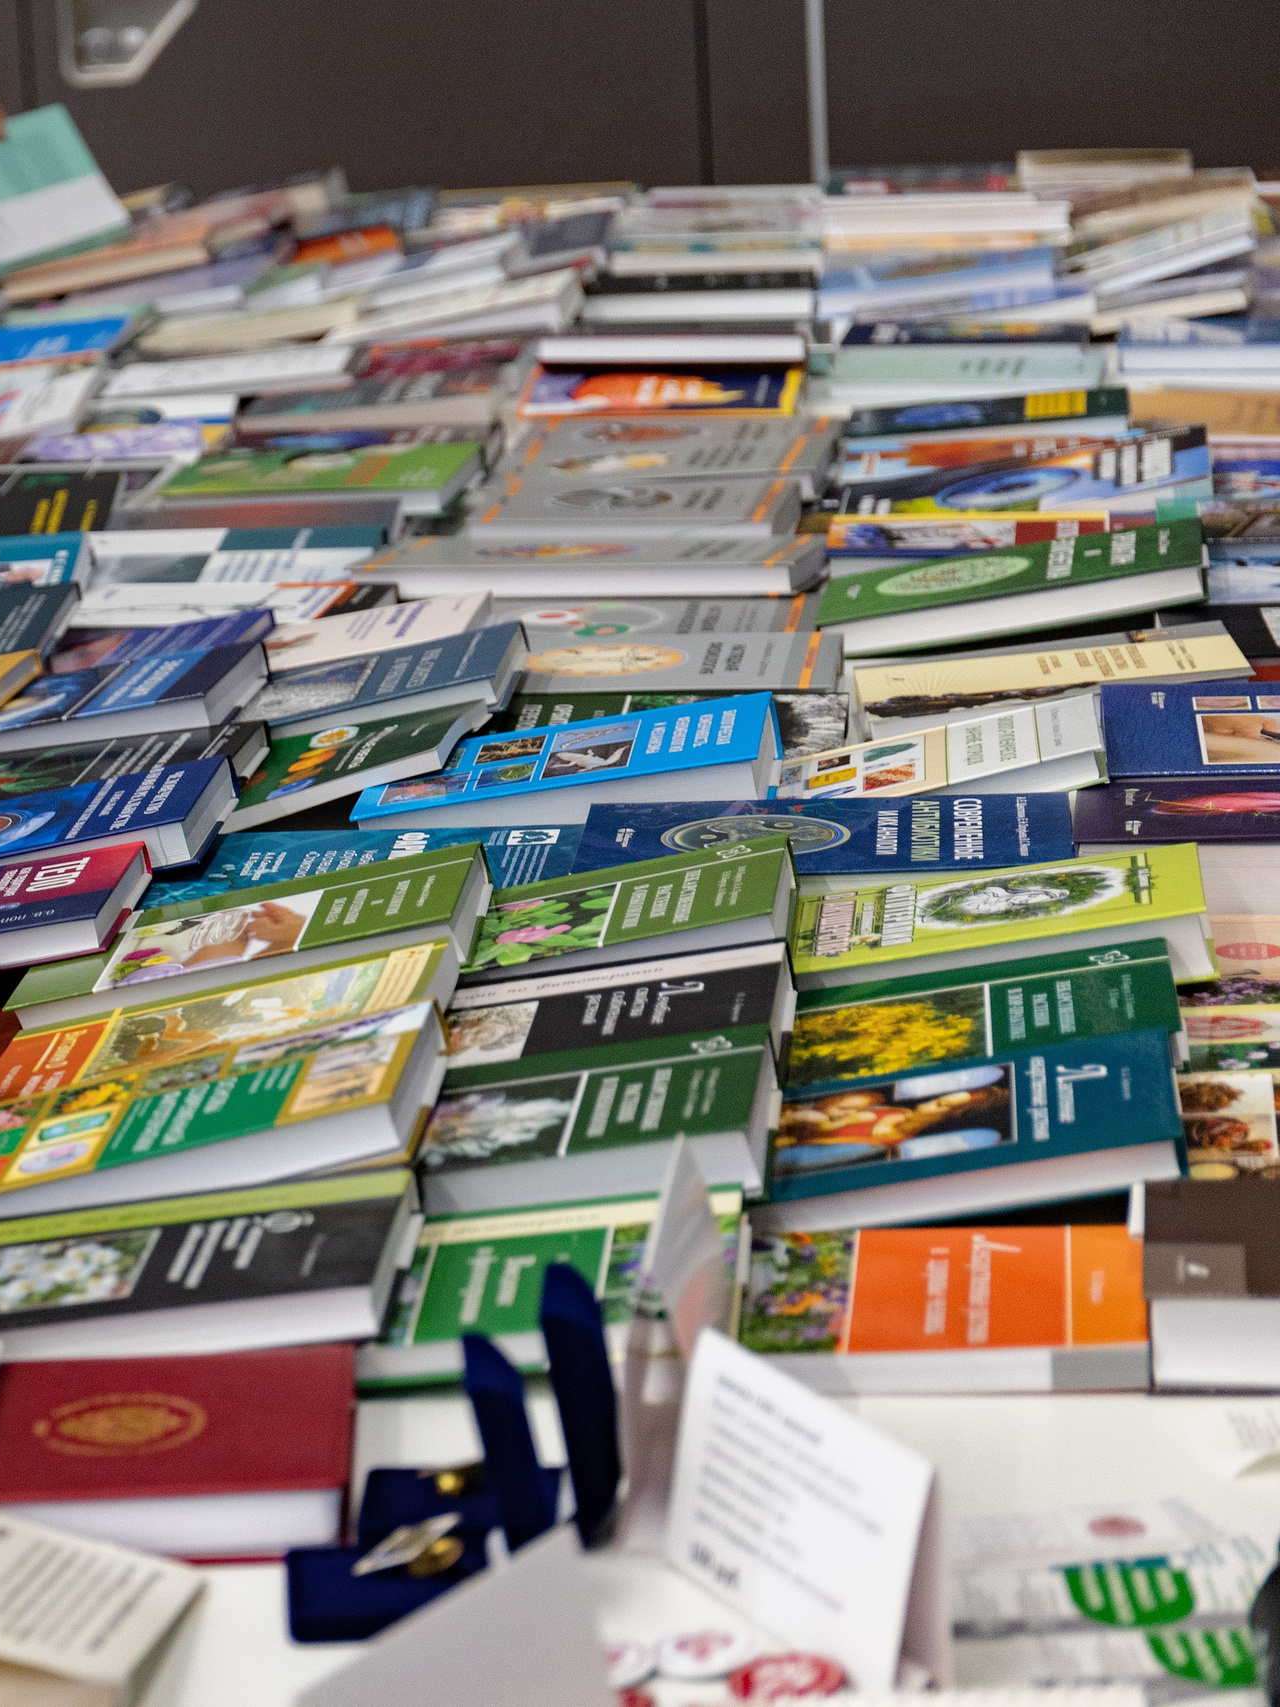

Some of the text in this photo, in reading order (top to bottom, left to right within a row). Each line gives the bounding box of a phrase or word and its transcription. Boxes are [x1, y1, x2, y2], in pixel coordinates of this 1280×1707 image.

[876, 816, 898, 825] ИХ
[911, 800, 939, 861] АНТИБИОТИКИ
[952, 798, 982, 859] СОВРЕМЕННЫЕ
[386, 831, 430, 859] ФАРМ
[876, 826, 897, 855] АНАЛОГИ
[22, 855, 91, 893] ТЕЛО
[881, 884, 915, 946] ФИТОТЕРАПИЯ
